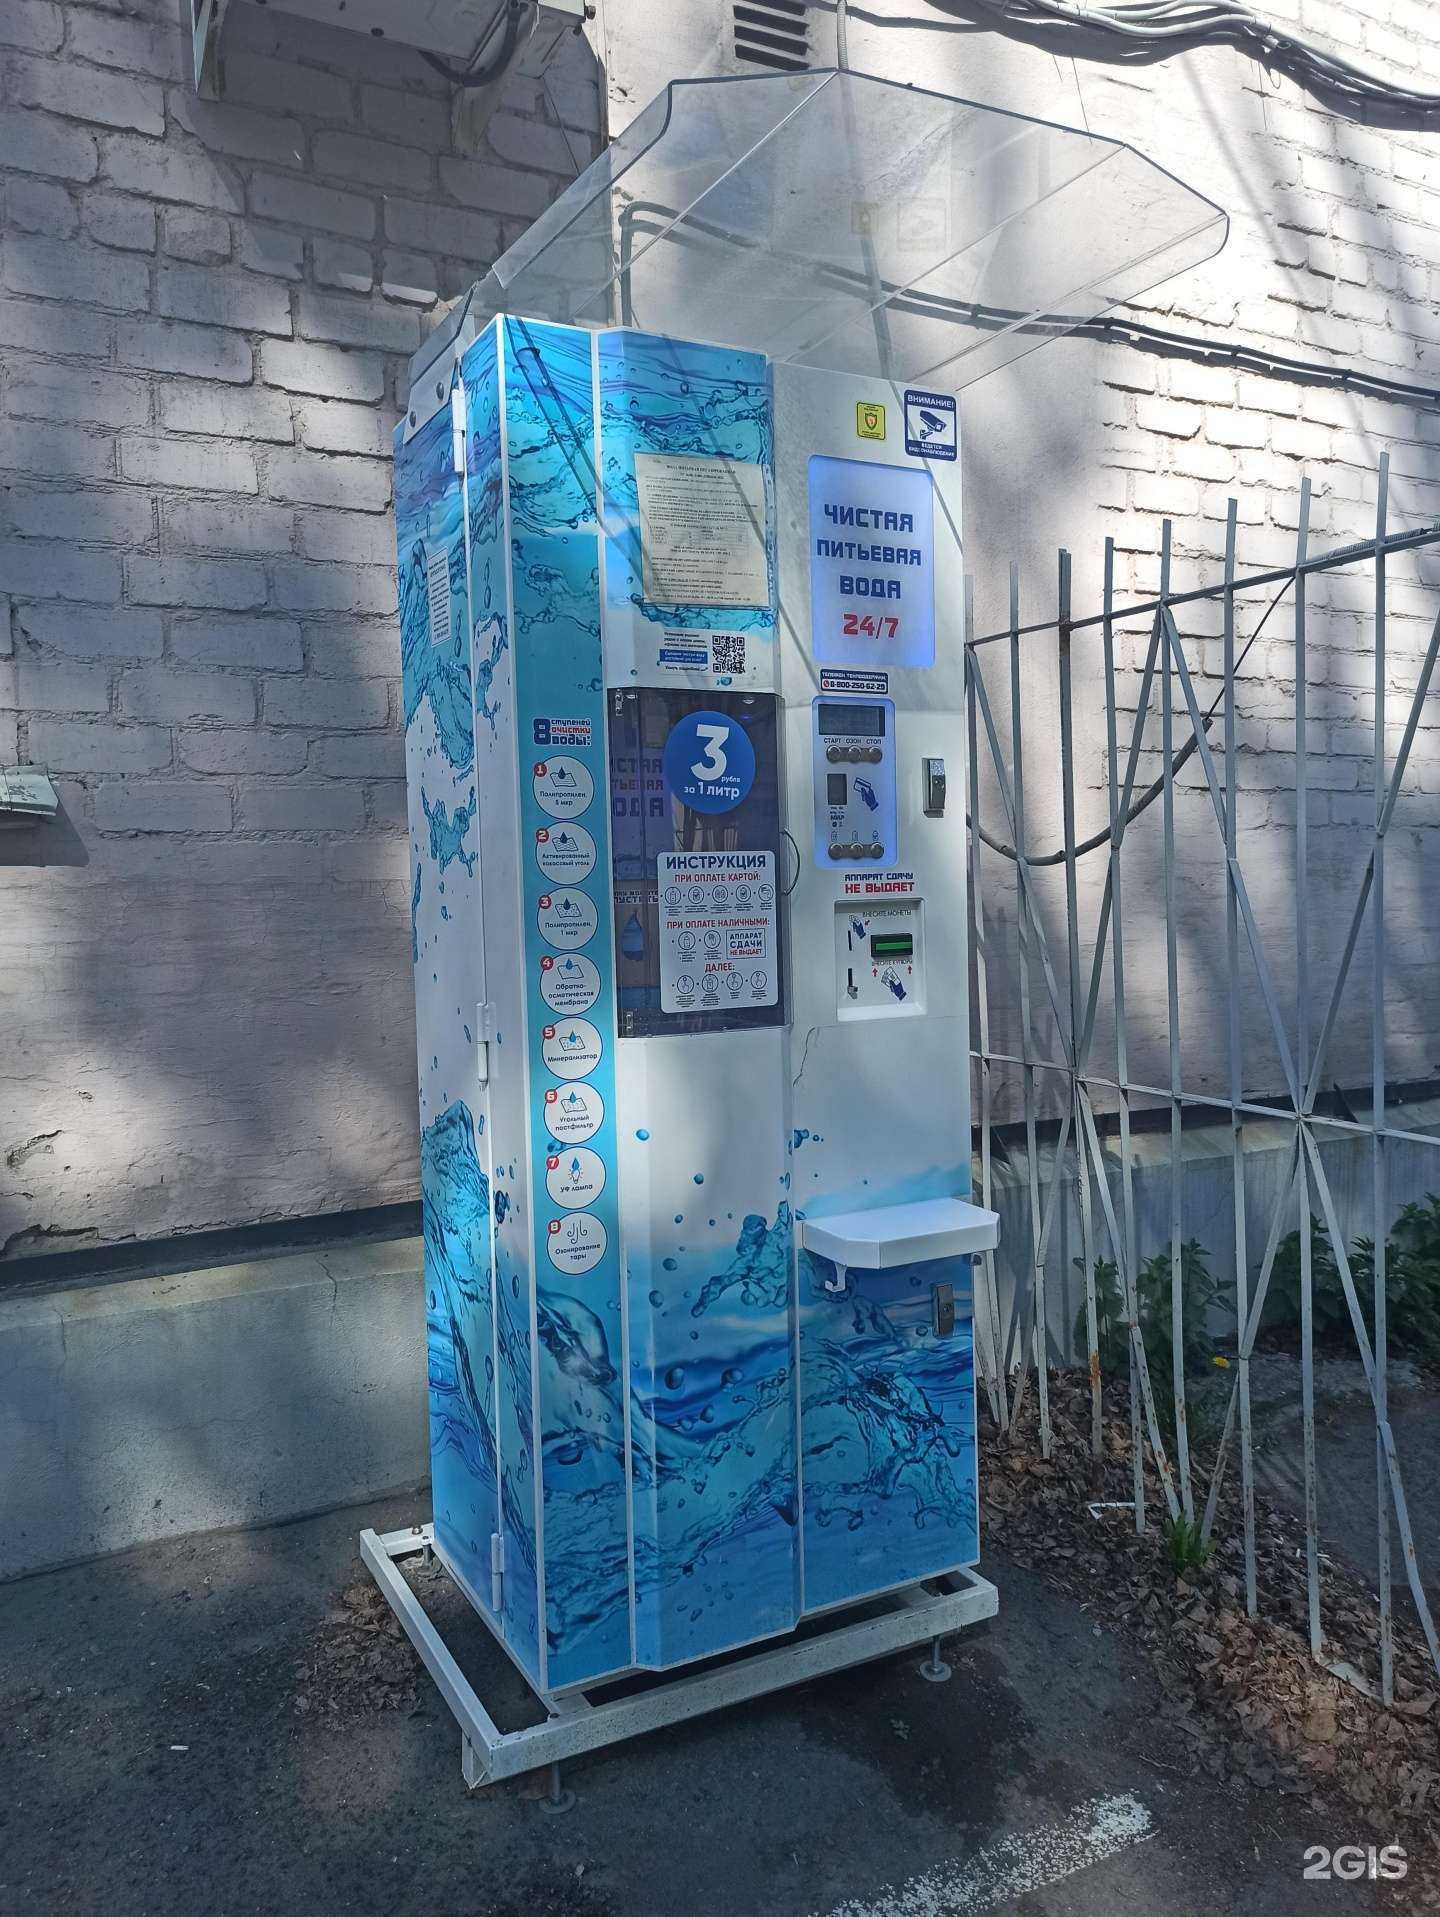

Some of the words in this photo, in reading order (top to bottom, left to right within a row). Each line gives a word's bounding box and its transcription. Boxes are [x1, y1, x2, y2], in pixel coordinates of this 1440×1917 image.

[907, 394, 954, 409] ВНИМАНИЕ!
[824, 504, 913, 532] ЧИСТАЯ
[817, 539, 921, 566] ПИТЬЕВАЯ
[839, 575, 901, 600] ВОДА
[843, 613, 899, 639] 24/7
[533, 718, 551, 745] 8
[551, 734, 591, 746] воды:
[690, 724, 730, 781] 3
[684, 786, 695, 794] за
[698, 782, 704, 794] 1
[706, 784, 740, 800] литр
[538, 831, 546, 840] 2
[666, 855, 766, 870] ИНСТРУКЦИЯ
[674, 874, 692, 883] ПРИ
[694, 873, 726, 882] ОПЛАТЕ
[728, 870, 761, 881] КАРТОЙ:
[845, 873, 884, 882] АППАРАТ
[886, 872, 914, 880] СДАЧУ
[845, 883, 861, 894] НЕ
[865, 882, 915, 893] ВЫДАЕТ
[666, 921, 683, 929] ПРИ
[685, 919, 716, 928] ОПЛАТЕ
[718, 918, 770, 927] НАЛИЧНЫМИ:
[730, 932, 763, 940] АППАРАТ
[730, 940, 763, 949] СДАЧИ
[543, 958, 551, 968] 4
[705, 963, 735, 973] ДАЛЕЕ:
[545, 1027, 553, 1036] 5
[548, 1054, 597, 1062] Минерализатор
[547, 1092, 554, 1101] 6
[549, 1159, 557, 1167] 7
[550, 1222, 558, 1231] 8
[555, 1243, 601, 1255] Озонирование
